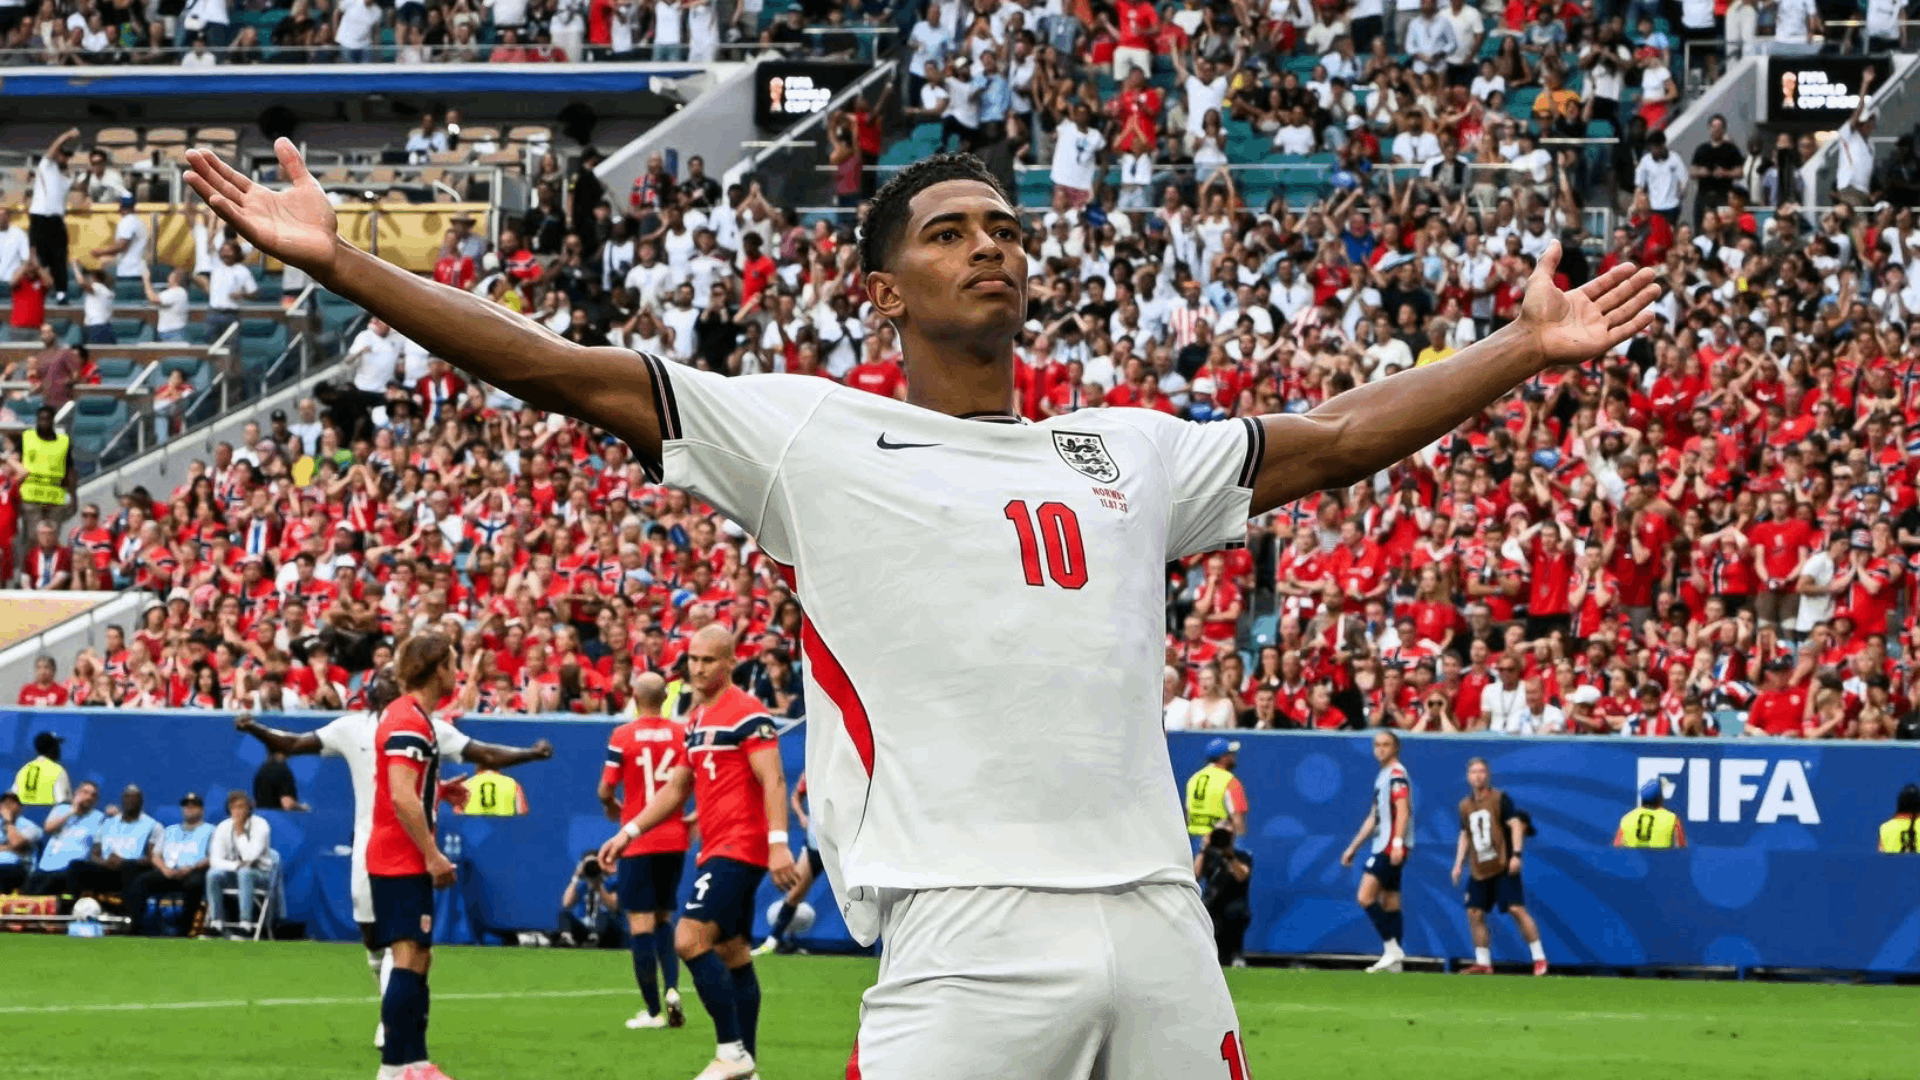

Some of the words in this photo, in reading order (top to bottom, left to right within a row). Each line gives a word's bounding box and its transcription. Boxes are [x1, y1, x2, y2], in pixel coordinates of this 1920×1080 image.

[1092, 487, 1127, 500] NORWAY
[1003, 499, 1088, 590] 10
[702, 752, 717, 781] 4
[1637, 757, 1821, 824] FIFA
